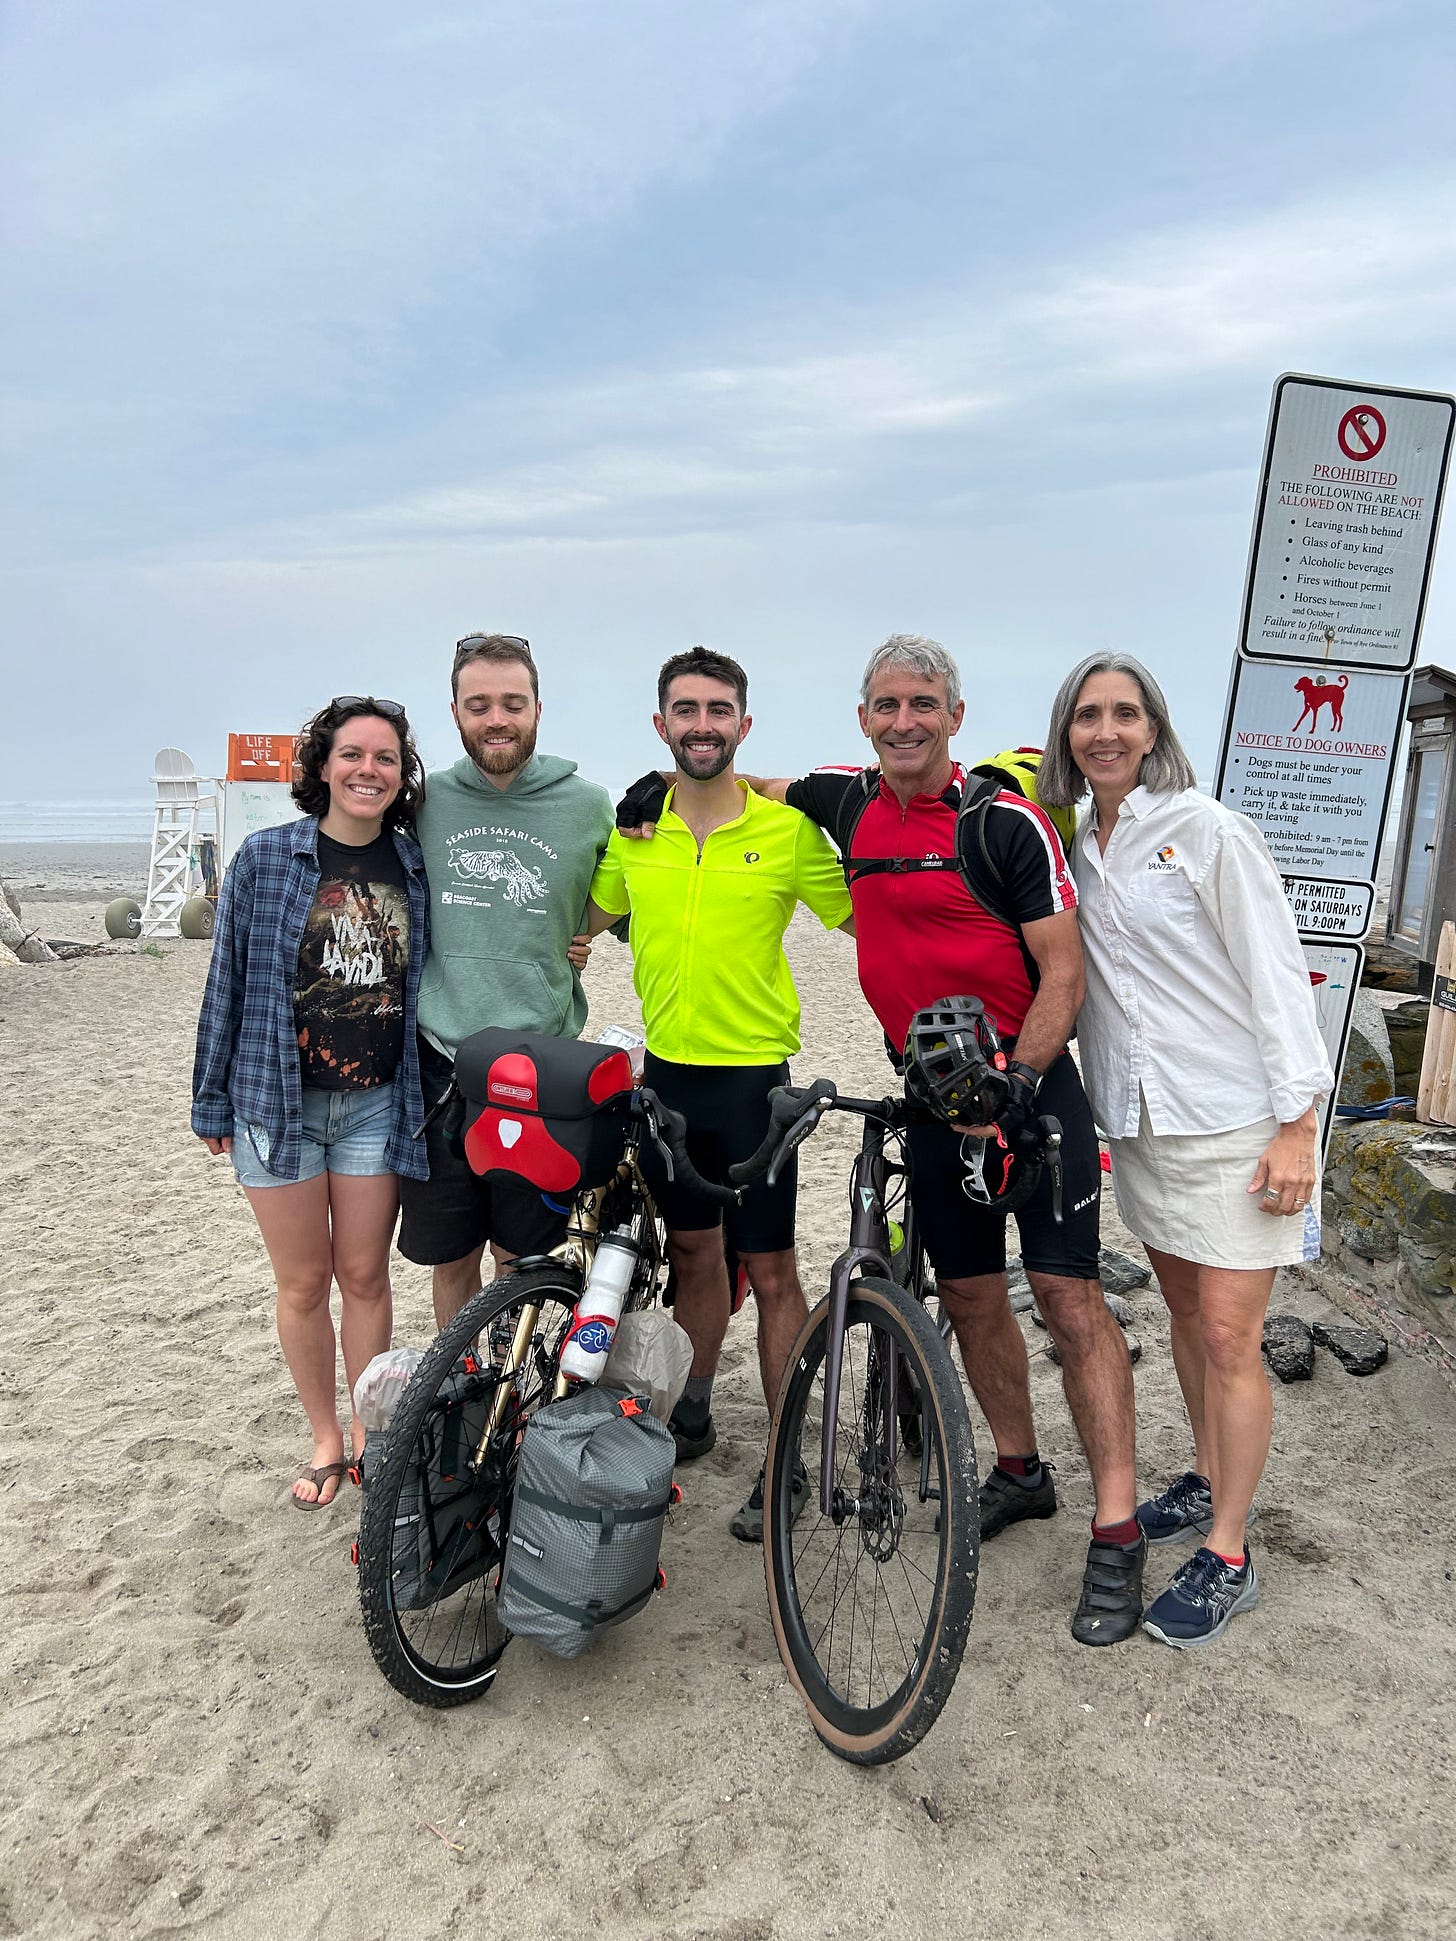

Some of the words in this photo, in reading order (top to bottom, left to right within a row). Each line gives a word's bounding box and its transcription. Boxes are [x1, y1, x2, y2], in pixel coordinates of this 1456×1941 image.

[1313, 464, 1398, 486] PROHIBITED
[1280, 481, 1303, 494] THE
[1305, 484, 1373, 502] FOLLOWING
[1374, 493, 1398, 505] ARE
[1400, 496, 1424, 508] NOT
[1278, 495, 1334, 510] ALLOWED
[1336, 501, 1354, 512] ON
[1356, 503, 1379, 516] THE
[1380, 506, 1422, 520] BEACH:
[1304, 517, 1344, 533] Leaving
[1346, 524, 1368, 534] trash
[1370, 525, 1403, 538] behind
[1302, 536, 1328, 548] Glass
[1330, 540, 1342, 550] of
[1342, 543, 1360, 554] any
[1362, 542, 1384, 554] kind
[1299, 555, 1345, 569] Alcoholic
[1348, 560, 1394, 576] beverages
[1297, 573, 1320, 586] Fires
[1323, 577, 1358, 590] without
[1360, 582, 1391, 593] permit
[1294, 592, 1327, 604] Horses
[1329, 598, 1358, 608] between
[1359, 602, 1376, 610] June
[1306, 608, 1334, 618] October
[1261, 629, 1287, 639] result
[1289, 630, 1297, 640] in
[1264, 615, 1296, 628] Failure
[1298, 620, 1307, 629] to
[1306, 620, 1336, 632] follow
[1337, 624, 1382, 636] ordinance
[1384, 628, 1401, 638] will
[246, 736, 272, 748] LIFE
[1236, 732, 1283, 747] NOTICE
[1286, 736, 1302, 749] TO
[1304, 738, 1332, 752] DOG
[1334, 741, 1387, 757] OWNERS
[252, 749, 271, 760] OFF
[1248, 756, 1273, 769] Dogs
[1275, 760, 1297, 769] must
[1300, 760, 1311, 771] be
[1313, 763, 1339, 773] under
[1341, 767, 1363, 776] your
[1246, 770, 1279, 780] control
[1281, 773, 1290, 781] at
[1292, 772, 1305, 782] all
[1307, 773, 1332, 784] times
[1243, 786, 1264, 796] Pick
[1266, 790, 1278, 799] up
[1281, 791, 1307, 800] waste
[1309, 791, 1367, 807] immediately,
[1241, 800, 1265, 810] carry
[1268, 800, 1277, 810] it,
[1280, 801, 1288, 810] &
[1292, 802, 1310, 812] take
[1313, 802, 1320, 813] it
[1322, 805, 1342, 814] with
[1344, 808, 1362, 818] you
[1265, 811, 1299, 825] leaving
[446, 826, 487, 846] SEASIDE
[490, 826, 529, 841] SAFARI
[530, 837, 558, 860] CAMP
[1274, 843, 1294, 851] before
[1295, 845, 1325, 854] Memorial
[1326, 847, 1339, 857] Day
[1353, 838, 1369, 846] from
[1148, 862, 1176, 870] YANTRA
[1292, 856, 1310, 864] Labor
[1311, 858, 1325, 867] Day
[1297, 884, 1346, 900] PERMITTED
[1294, 898, 1308, 912] ON
[1310, 900, 1363, 917] SATURDAYS
[1312, 915, 1346, 930] 9:00PM
